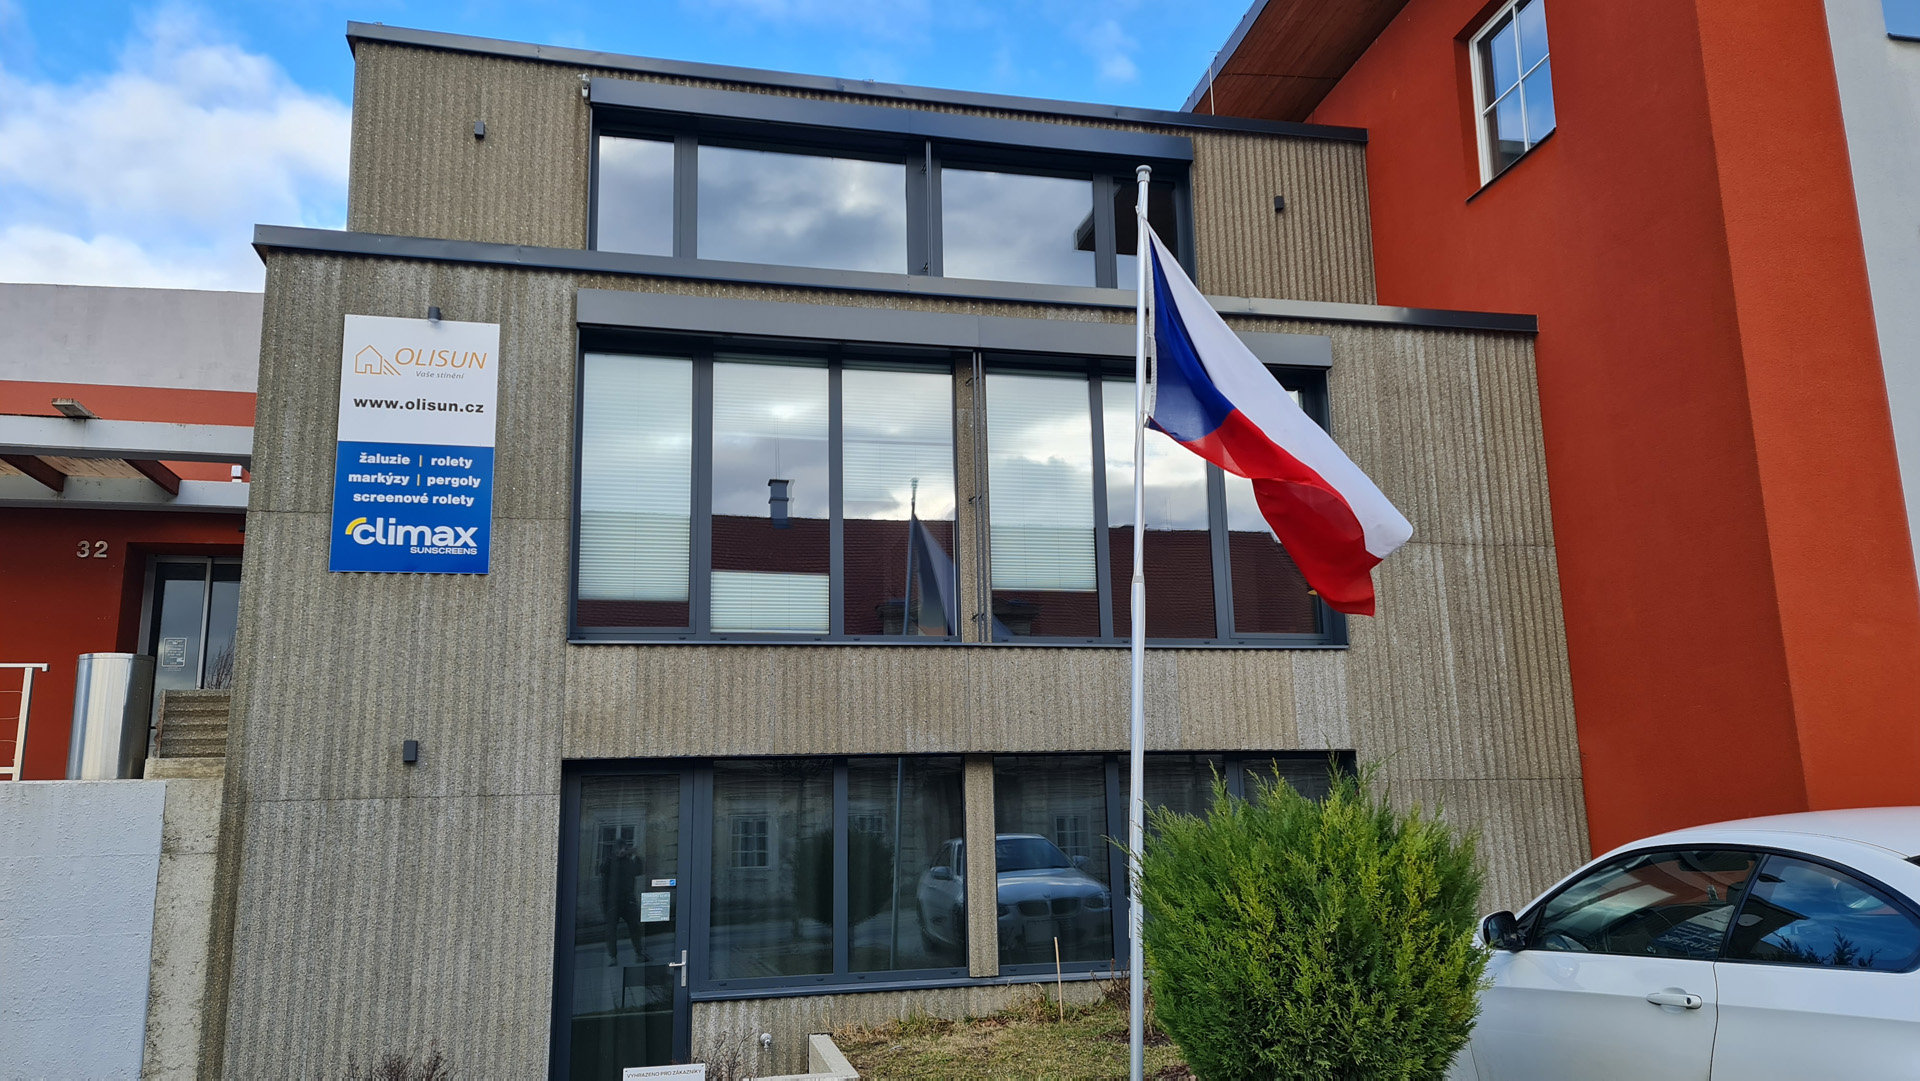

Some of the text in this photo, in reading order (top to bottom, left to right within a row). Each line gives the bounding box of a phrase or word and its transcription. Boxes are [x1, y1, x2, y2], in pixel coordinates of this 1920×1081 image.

[395, 347, 487, 369] OLISUN
[415, 370, 464, 379] Vaše stínění
[353, 398, 484, 413] www.olisun.cz
[359, 452, 473, 469] žaluzie rolety
[348, 472, 481, 488] markýzy pergoly
[353, 493, 474, 507] screenové rolety
[345, 517, 478, 547] climax
[76, 540, 109, 558] 32
[410, 546, 478, 555] SUNSCREENS
